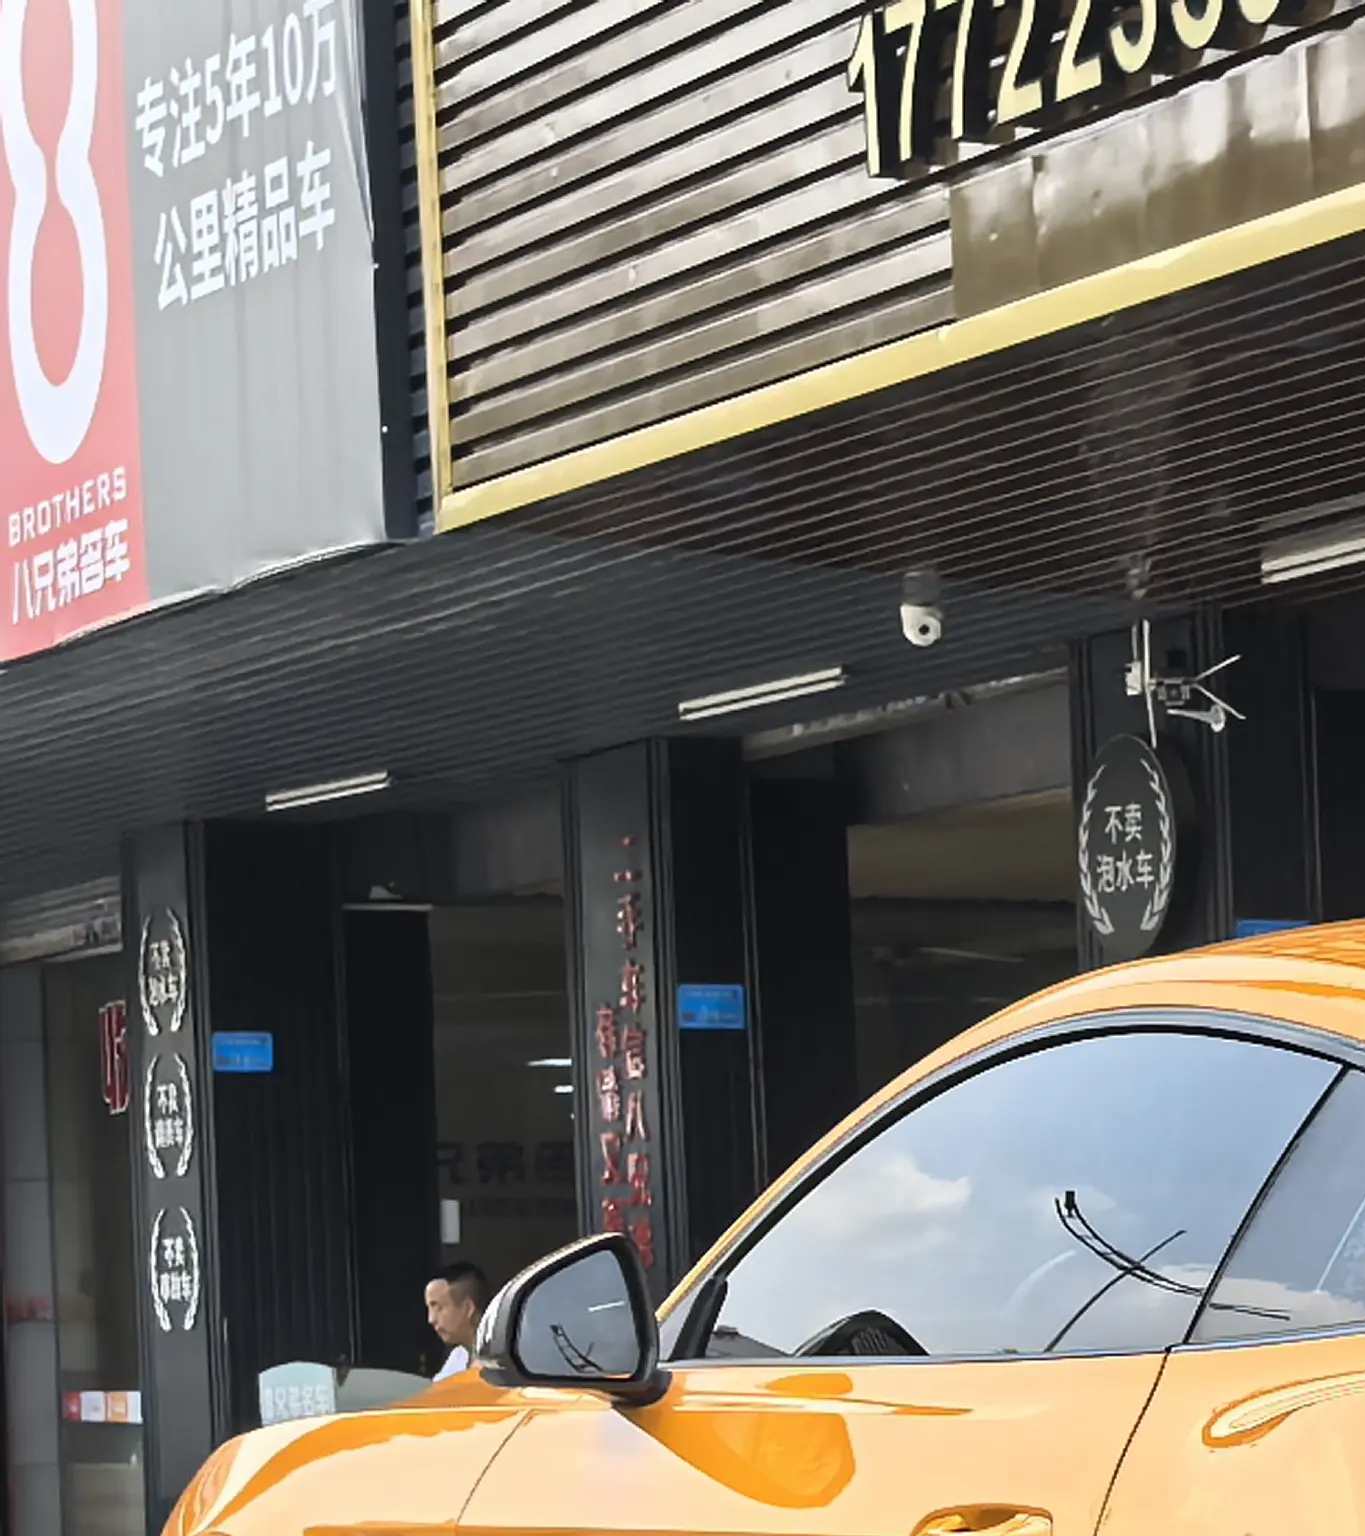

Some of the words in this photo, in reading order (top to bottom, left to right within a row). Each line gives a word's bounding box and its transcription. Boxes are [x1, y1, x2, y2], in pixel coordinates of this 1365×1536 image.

[135, 0, 337, 178] 专注5年10万
[153, 139, 336, 311] 公里精品车
[8, 465, 127, 547] BROTHERS
[1104, 803, 1143, 845] 不卖
[1097, 849, 1154, 893] 泡水车
